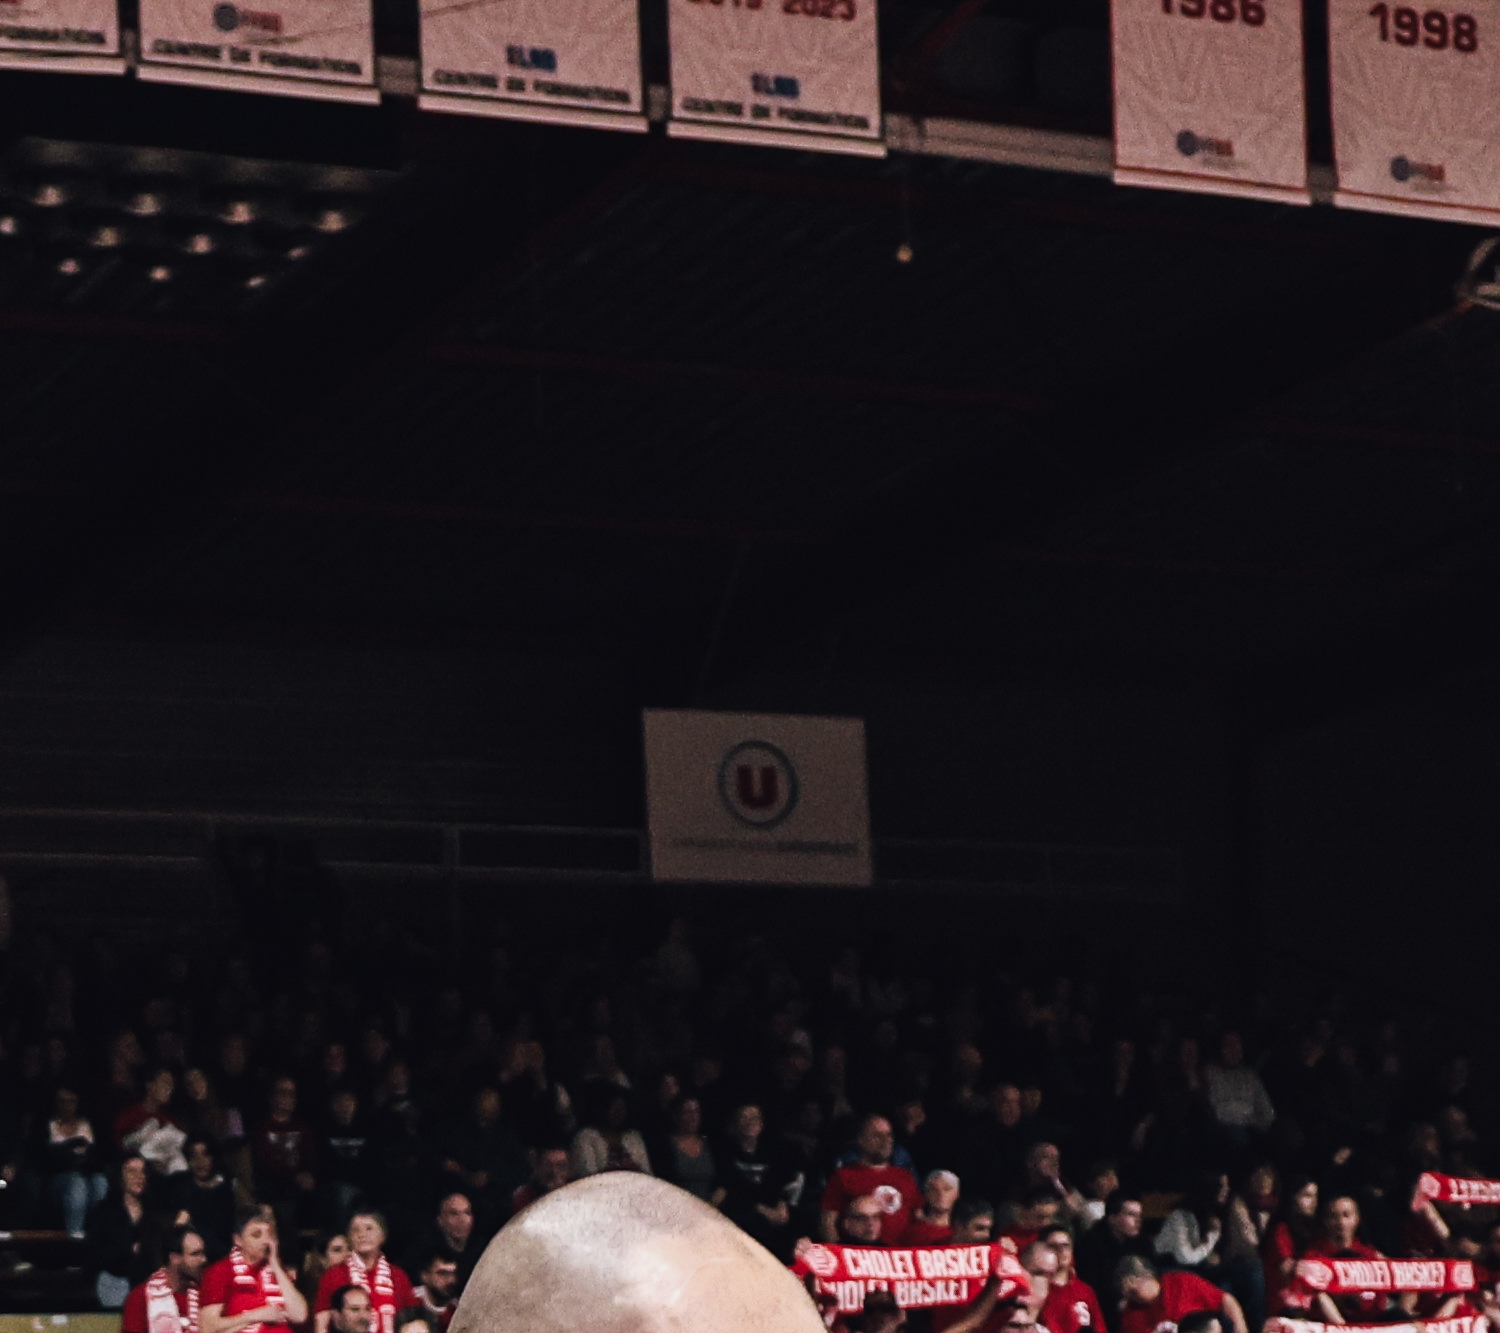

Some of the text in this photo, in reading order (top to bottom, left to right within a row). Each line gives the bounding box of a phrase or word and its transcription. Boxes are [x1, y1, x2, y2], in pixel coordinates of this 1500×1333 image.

[1368, 3, 1481, 55] 1998
[736, 764, 780, 811] U
[843, 1245, 992, 1280] CHOLET BASKET
